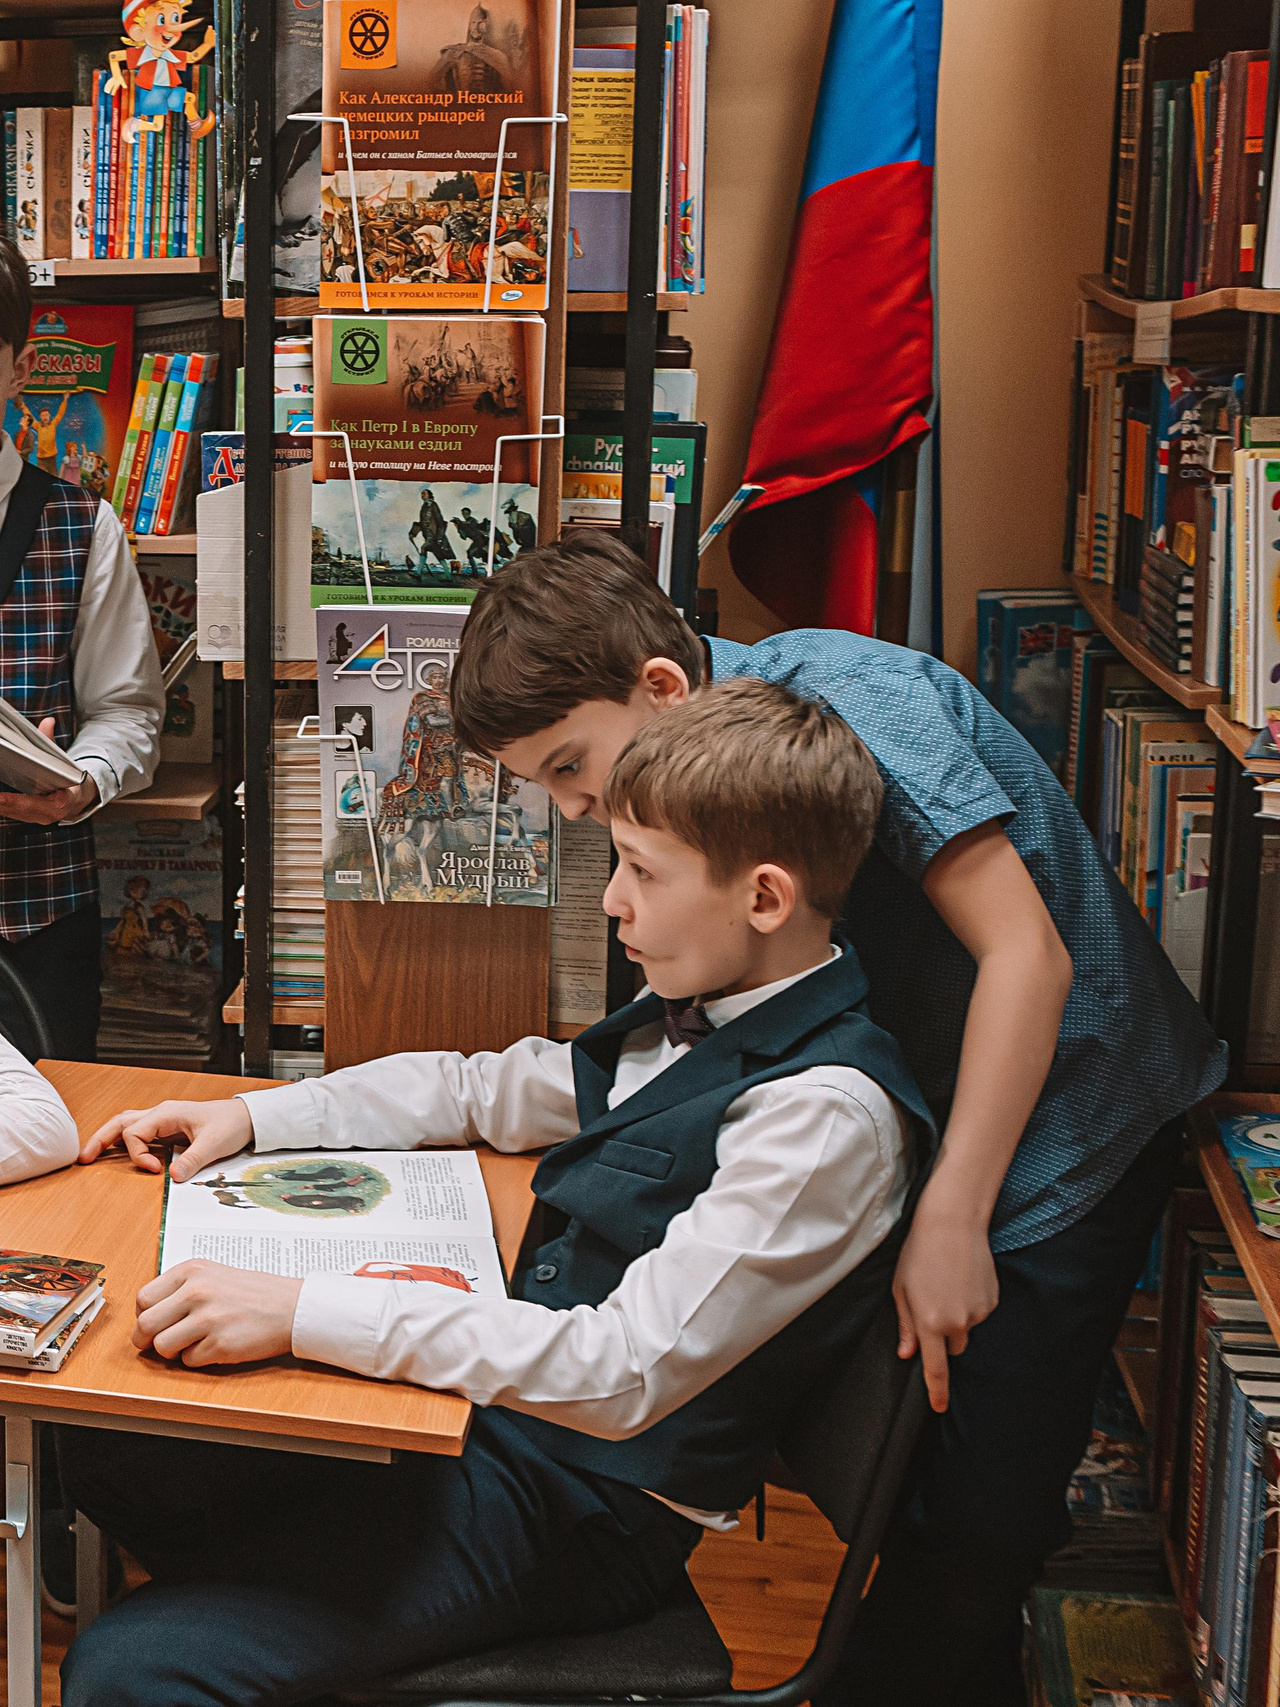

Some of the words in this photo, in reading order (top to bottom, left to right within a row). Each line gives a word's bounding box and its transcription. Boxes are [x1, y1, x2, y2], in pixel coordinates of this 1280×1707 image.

[349, 7, 389, 21] ОТКРЫВАЕМ
[352, 51, 384, 60] ИСТОРИЮ
[339, 91, 367, 104] Как
[371, 91, 454, 107] Александр
[457, 90, 524, 104] Невский
[339, 111, 414, 124] немецких
[418, 109, 485, 125] рыцарей
[339, 130, 420, 143] разгромил
[416, 150, 453, 159] Батыем
[454, 152, 517, 160] договаривлся
[5, 144, 17, 196] СКАЗОК
[398, 291, 434, 299] УРОКАМ
[340, 327, 380, 340] ОТКРЫВАЕМ
[343, 368, 376, 376] ИСТОРИЮ
[330, 420, 358, 432] Как
[362, 420, 398, 435] Петр
[402, 421, 407, 432] I
[412, 424, 420, 432] в
[424, 421, 478, 436] Европу
[330, 439, 345, 448] за
[351, 440, 414, 451] науками
[418, 440, 462, 451] ездил
[370, 462, 412, 471] столицу
[428, 461, 451, 470] Неве
[406, 637, 459, 648] РОМАН-Г
[439, 852, 530, 873] Ярослав
[437, 869, 530, 893] Мудрый
